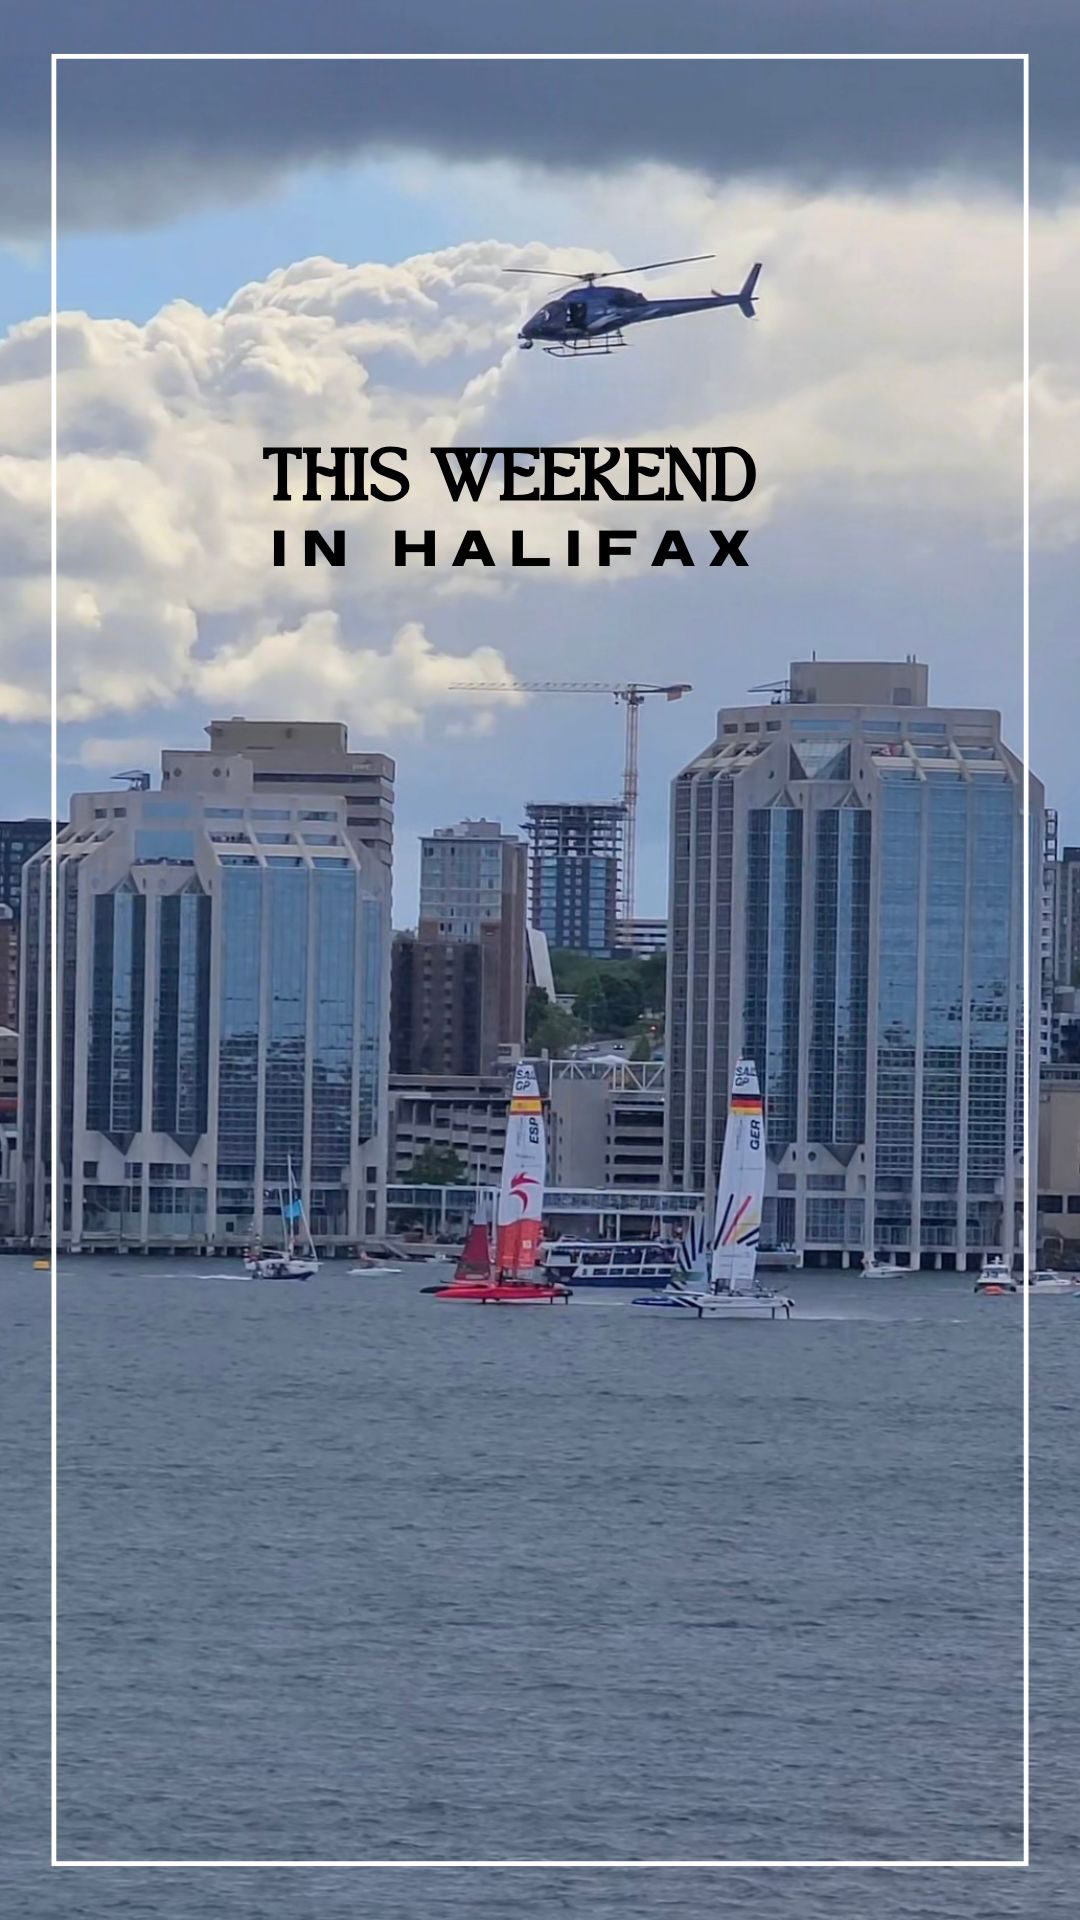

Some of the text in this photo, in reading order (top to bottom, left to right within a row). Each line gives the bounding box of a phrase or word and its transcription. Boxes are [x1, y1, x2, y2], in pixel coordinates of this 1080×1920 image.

[515, 1080, 531, 1091] GP
[735, 1077, 750, 1086] GP
[528, 1117, 540, 1144] ESP
[750, 1119, 761, 1150] GER
